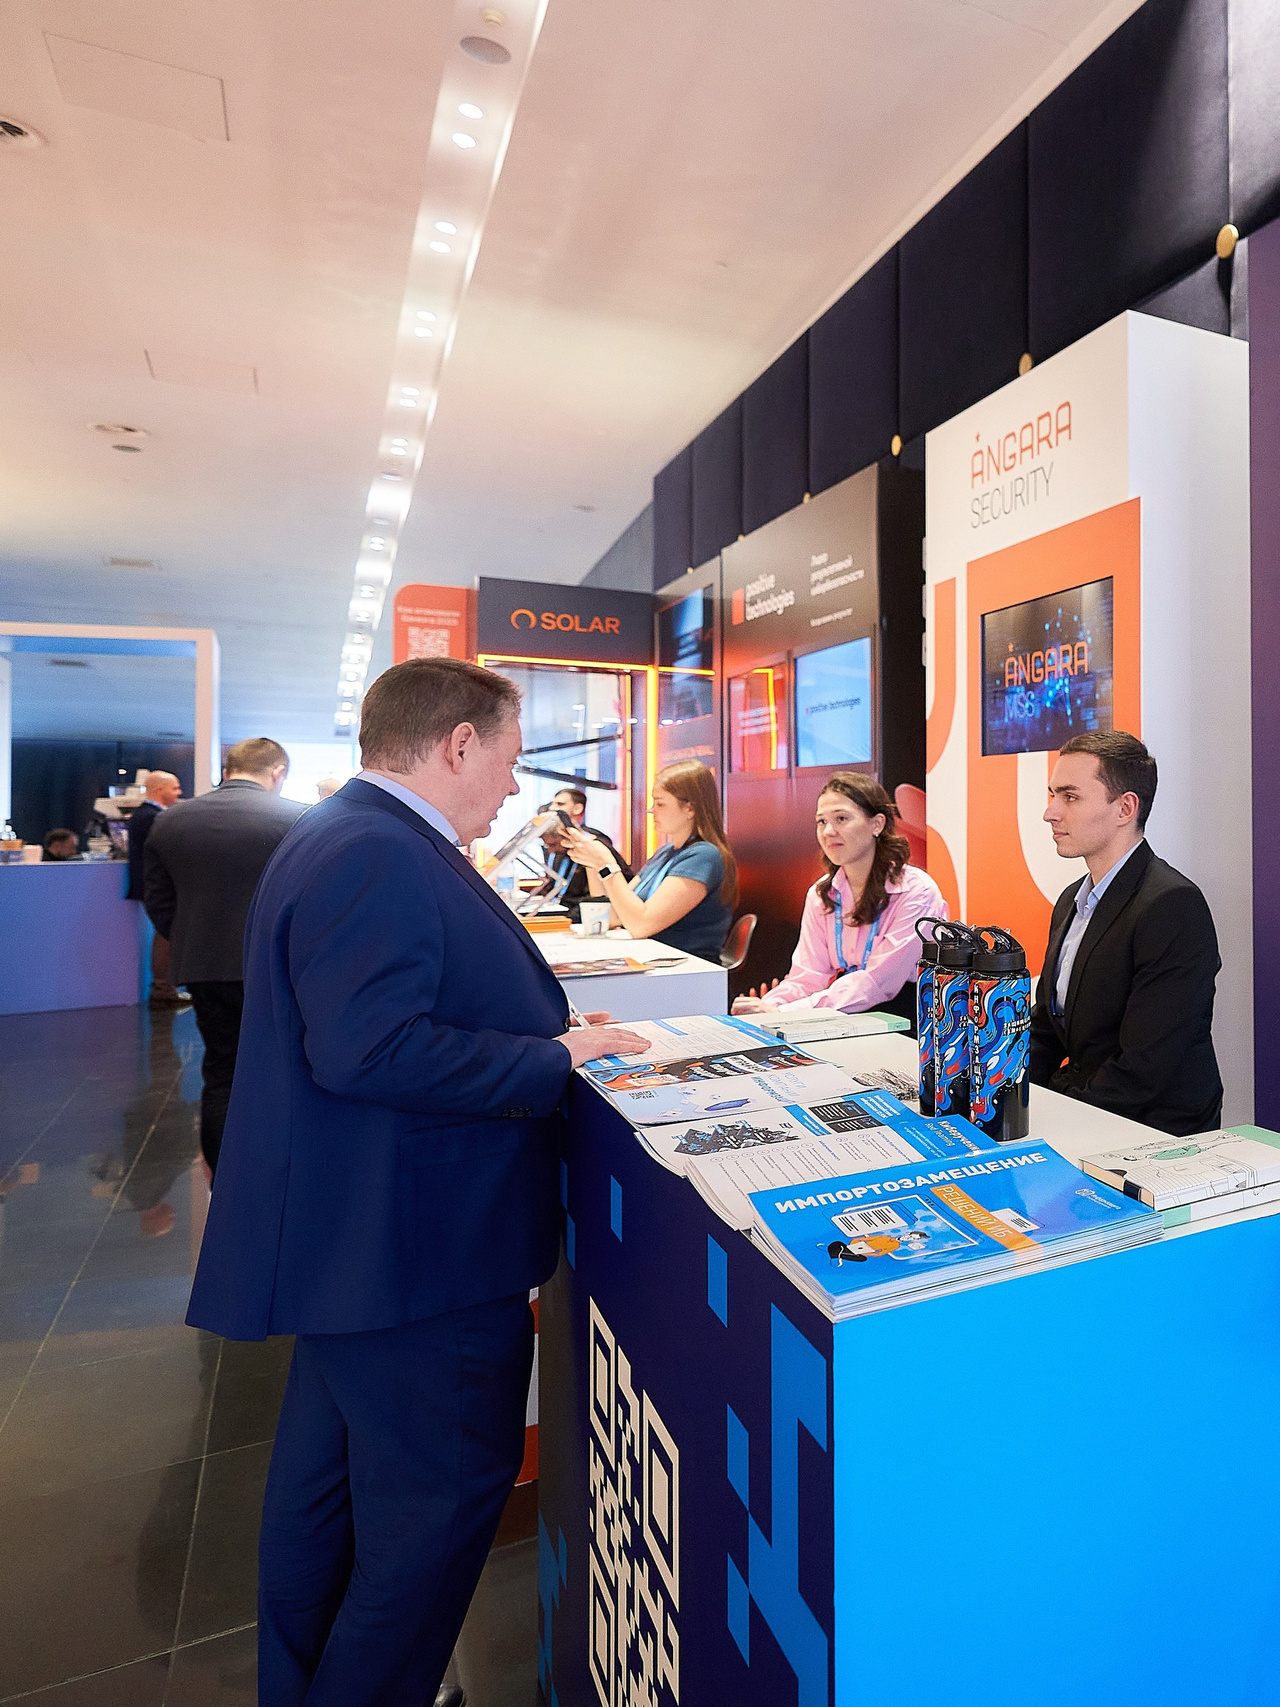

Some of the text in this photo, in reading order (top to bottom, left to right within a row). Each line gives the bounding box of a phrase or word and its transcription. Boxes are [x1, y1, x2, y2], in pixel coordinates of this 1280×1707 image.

[970, 461, 1055, 529] SECURITY
[539, 611, 621, 635] SOLAR
[1003, 690, 1036, 720] MSS
[775, 1152, 1048, 1214] ИМПОРТОЗАМЕЩЕНИЕ
[937, 1186, 1011, 1239] РЕШЕНИЙ ИБ
